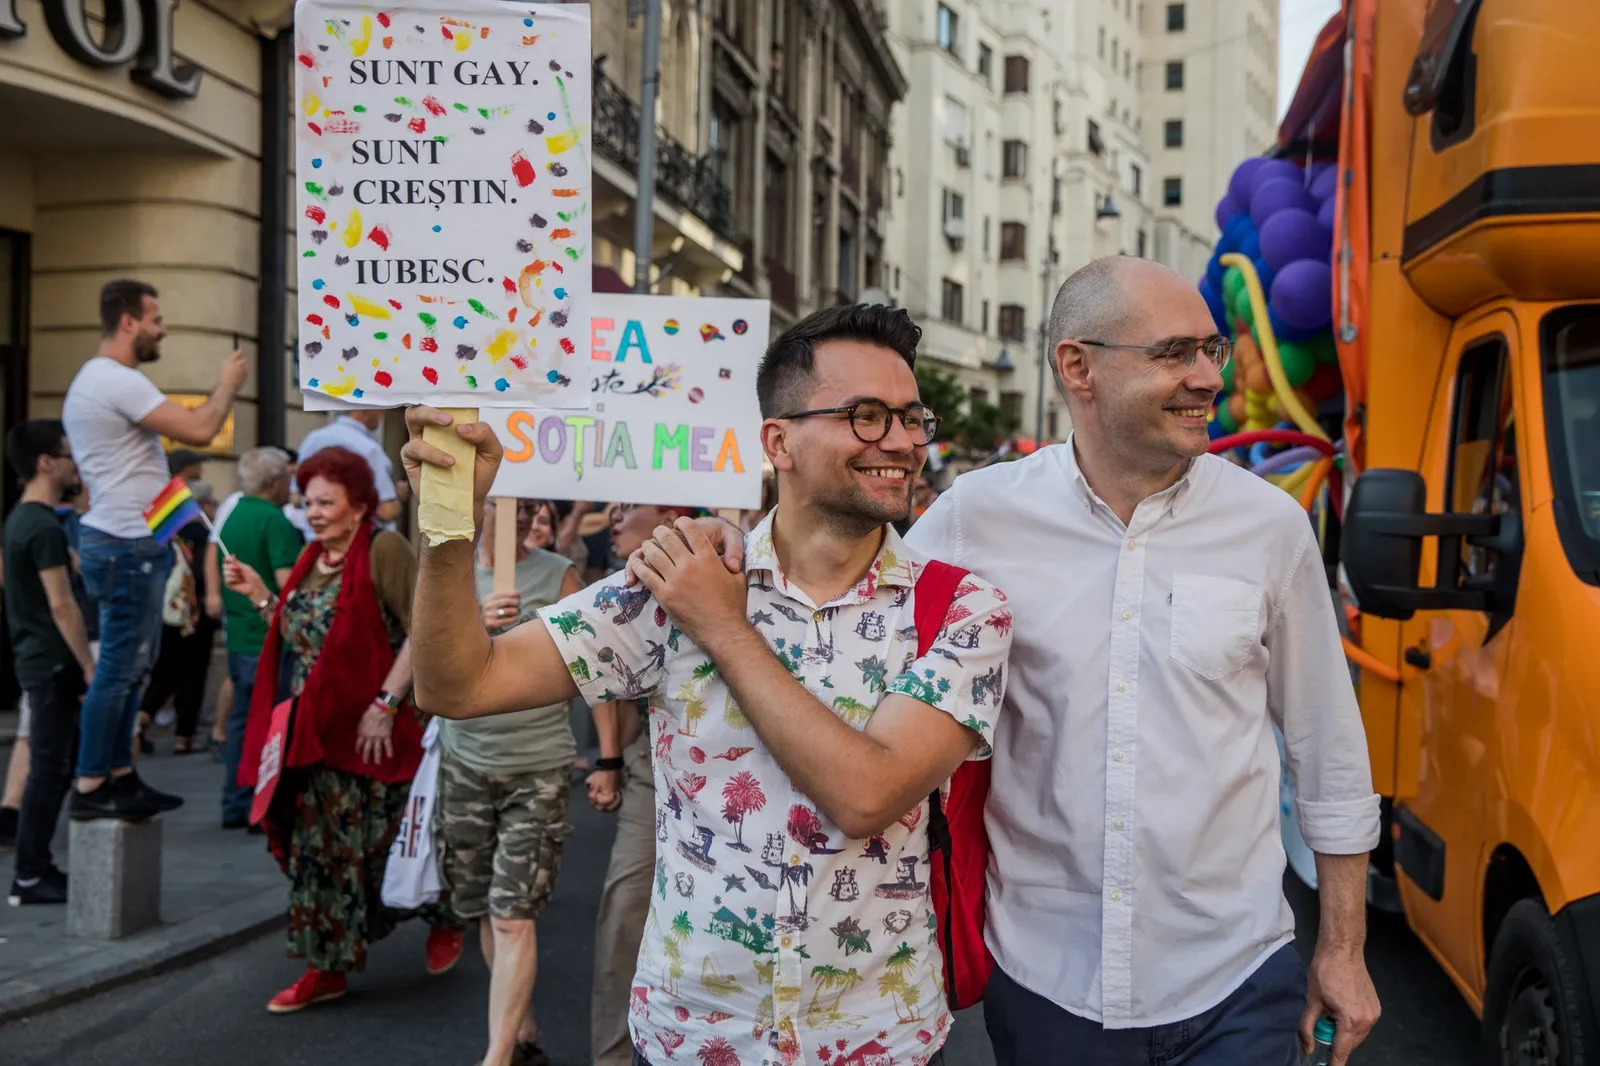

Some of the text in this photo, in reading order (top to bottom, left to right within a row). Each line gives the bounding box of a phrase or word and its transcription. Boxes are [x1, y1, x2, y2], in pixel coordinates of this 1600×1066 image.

[0, 0, 203, 98] OL
[349, 60, 539, 86] SUNT GAY.
[352, 137, 445, 165] SUNT
[353, 178, 517, 211] CREȘTIN.
[356, 258, 494, 285] IUBESC.
[591, 368, 634, 394] ste
[503, 409, 746, 482] SOȚIA MEA
